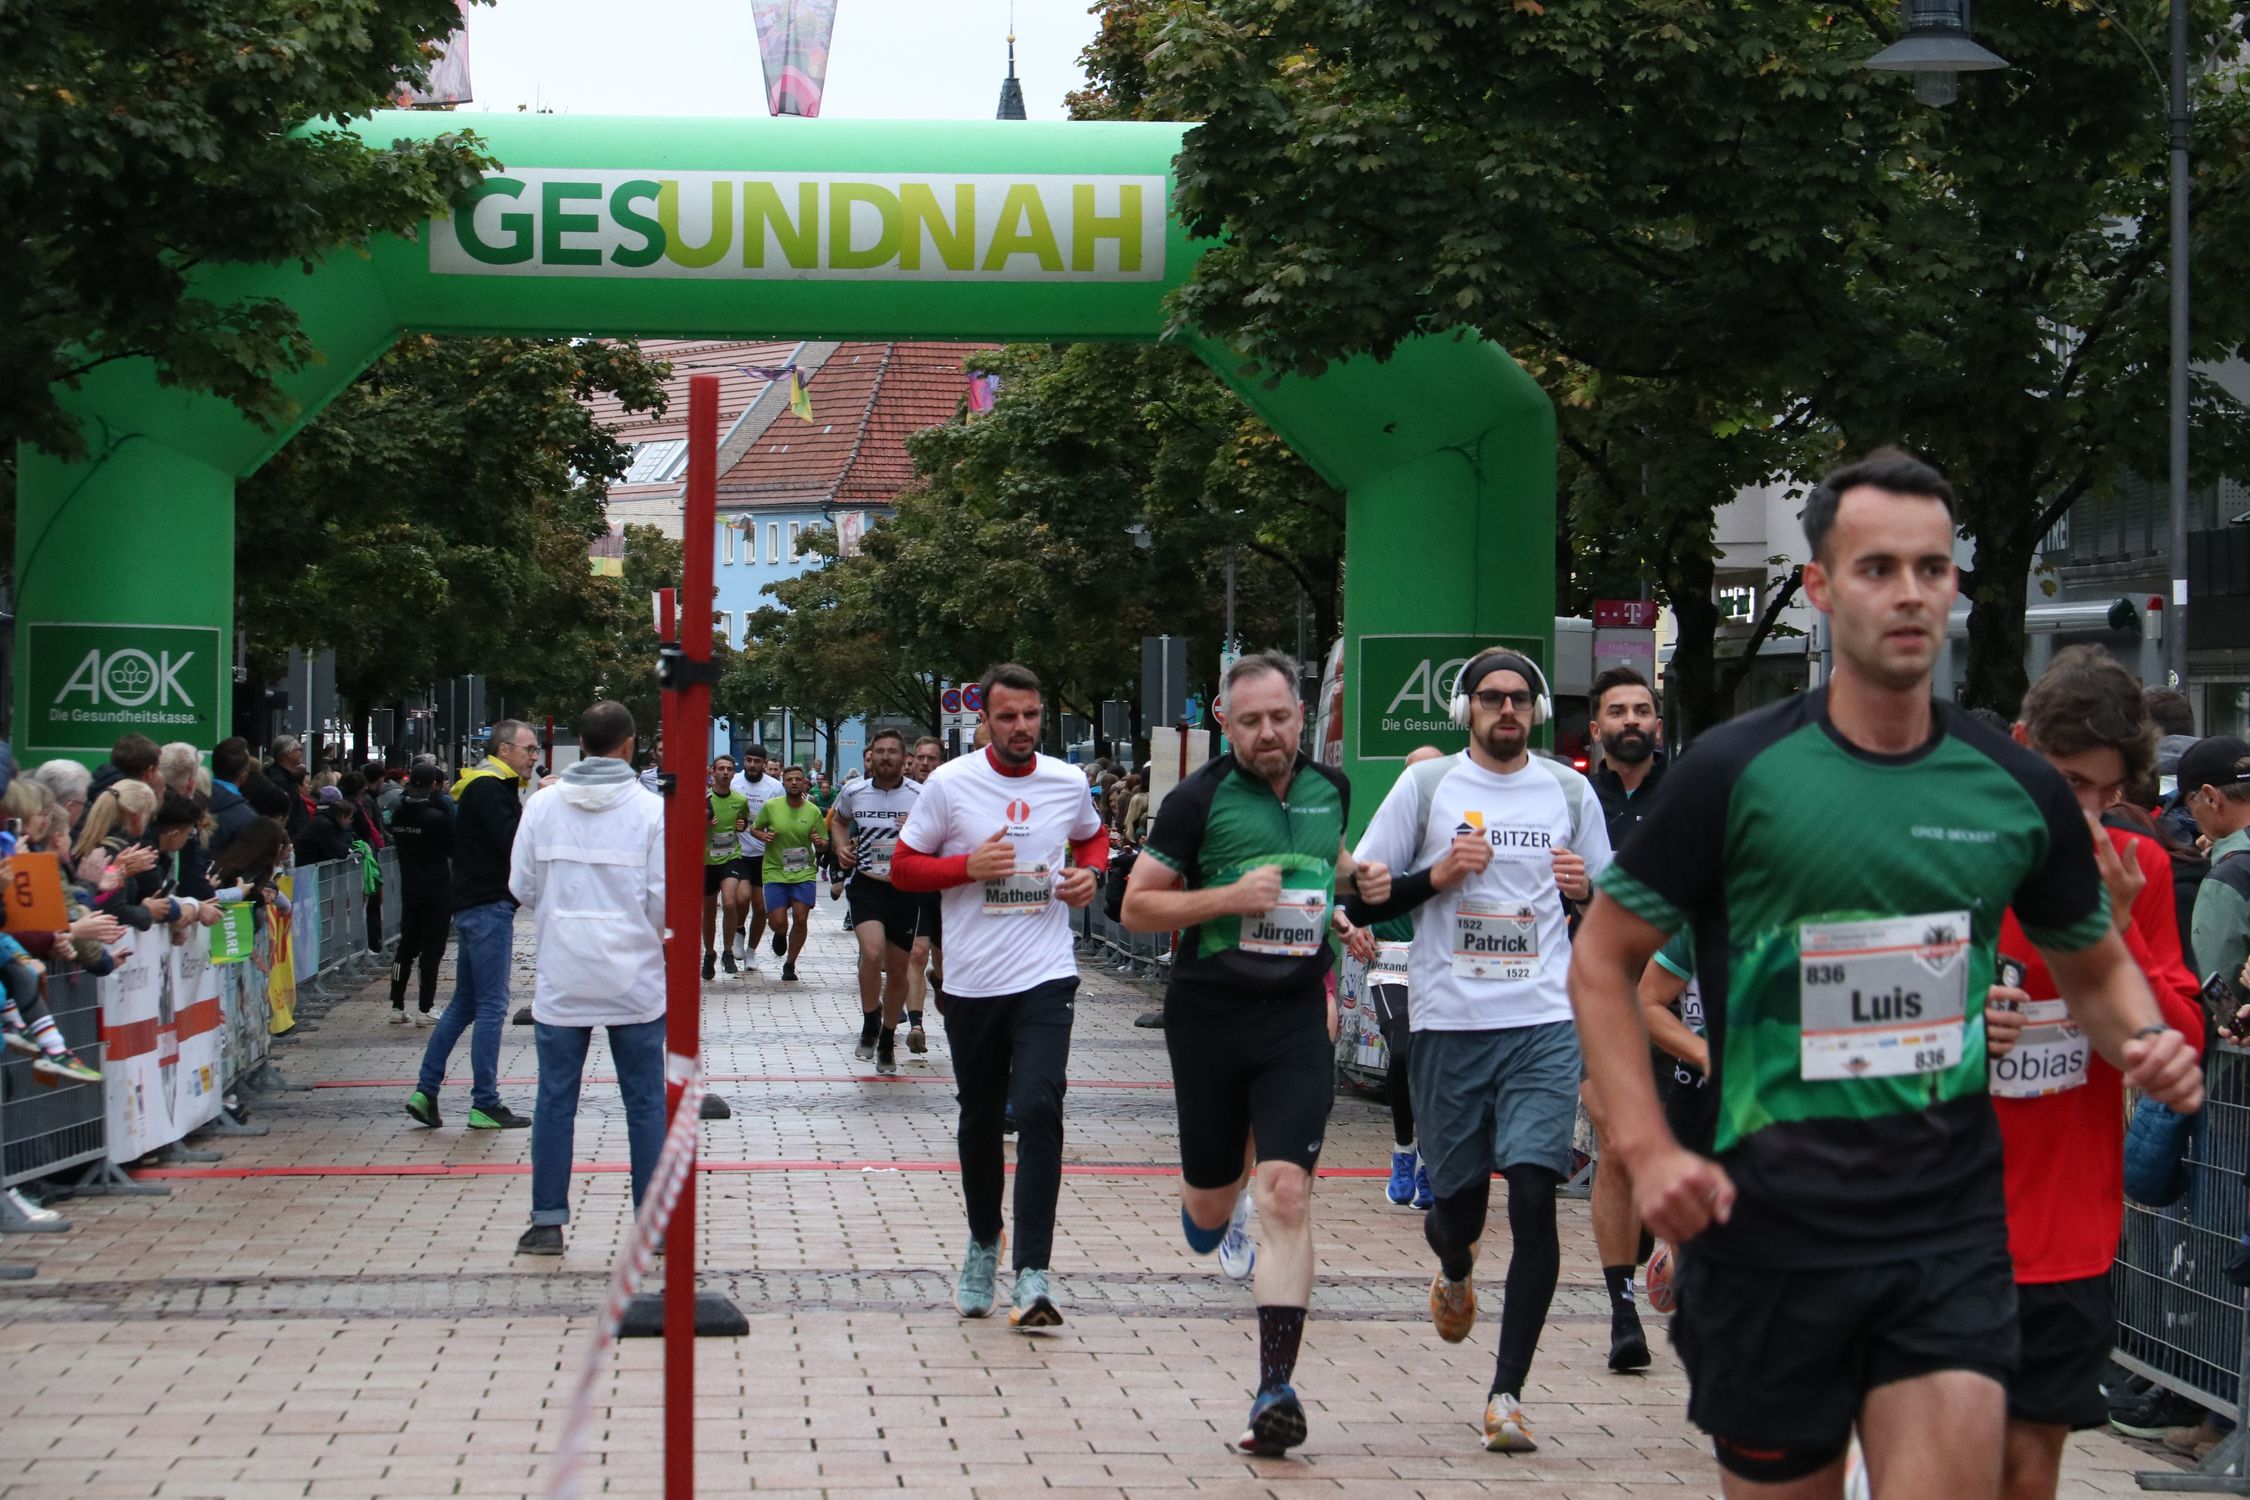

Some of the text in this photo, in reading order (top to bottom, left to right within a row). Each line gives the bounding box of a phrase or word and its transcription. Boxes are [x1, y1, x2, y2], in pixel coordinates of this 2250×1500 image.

[454, 176, 1142, 273] GESUNDNAH
[53, 648, 195, 707] AOK
[1385, 657, 1470, 716] AO
[50, 708, 197, 724] Die Gesundheitskasse.
[1381, 718, 1400, 731] Die
[1491, 830, 1552, 848] BITZER
[985, 888, 1049, 904] Matheus
[1252, 921, 1314, 944] Jürgen
[1457, 919, 1483, 930] 1522
[1463, 933, 1528, 953] Patrick
[1367, 960, 1408, 973] Alexand
[1506, 968, 1530, 978] 1522
[1806, 964, 1846, 986] 836
[1851, 986, 1923, 1023] Luis
[1915, 1048, 1945, 1070] 836
[1996, 1047, 2084, 1081] obias
